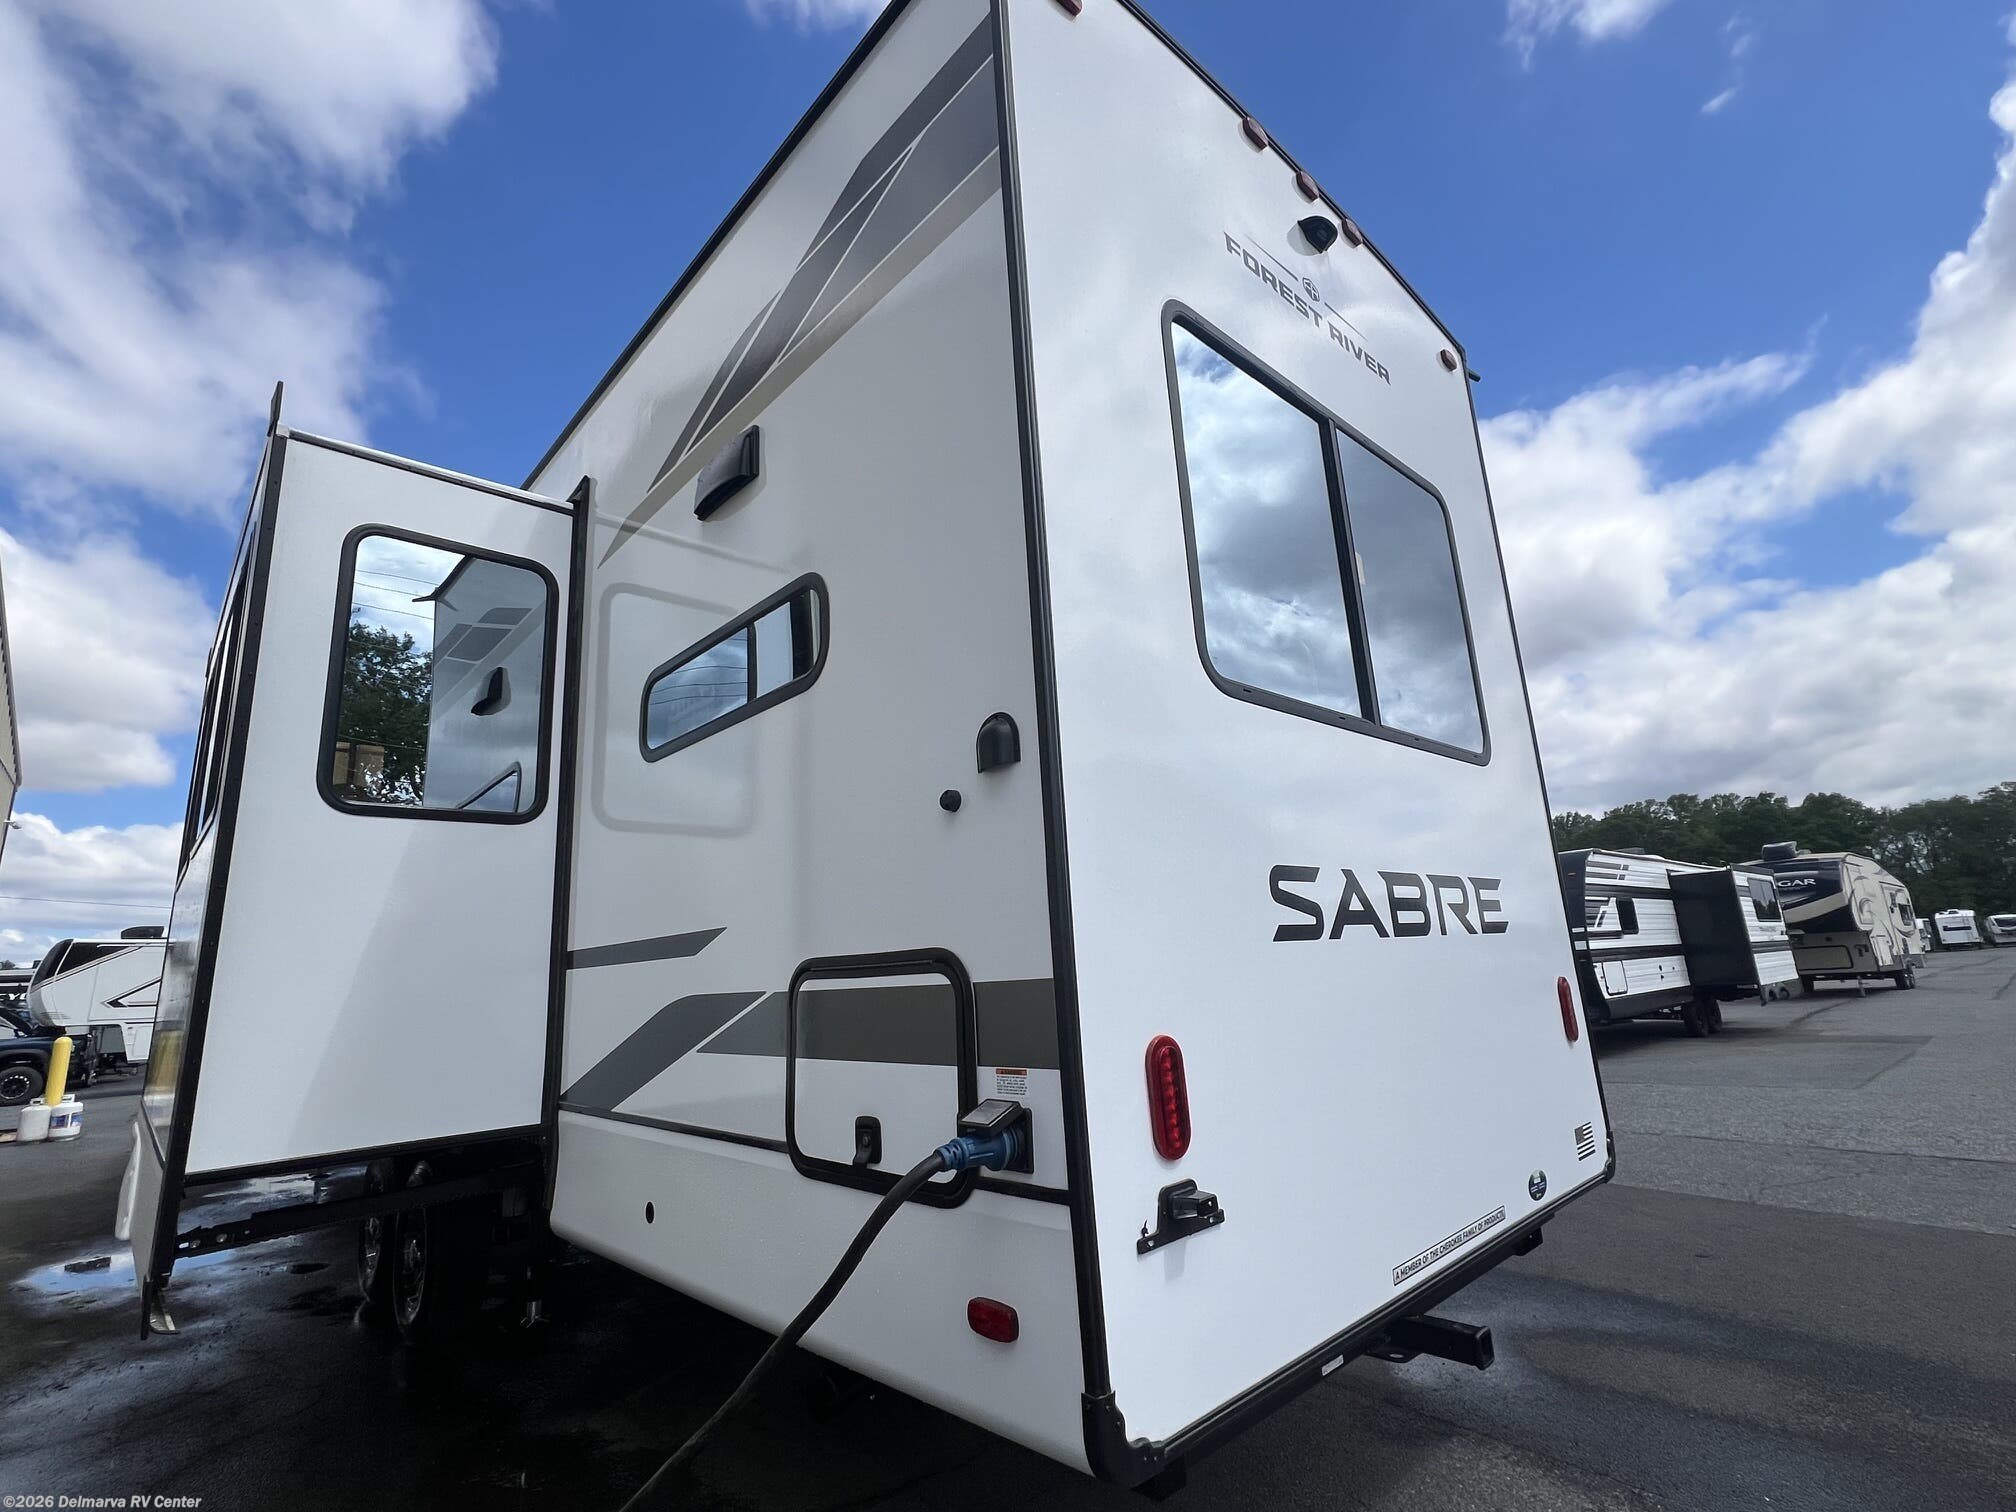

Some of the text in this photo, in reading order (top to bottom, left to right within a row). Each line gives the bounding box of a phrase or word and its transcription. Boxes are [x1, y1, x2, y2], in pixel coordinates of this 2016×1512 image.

[1224, 231, 1391, 386] FOREST RIVER
[1269, 864, 1509, 942] SABRE
[1400, 1257, 1422, 1276] MEMBER
[1422, 1253, 1429, 1264] OF
[1430, 1247, 1439, 1260] THE
[1439, 1233, 1463, 1254] CHEROKEE
[1463, 1224, 1478, 1240] FAMILY
